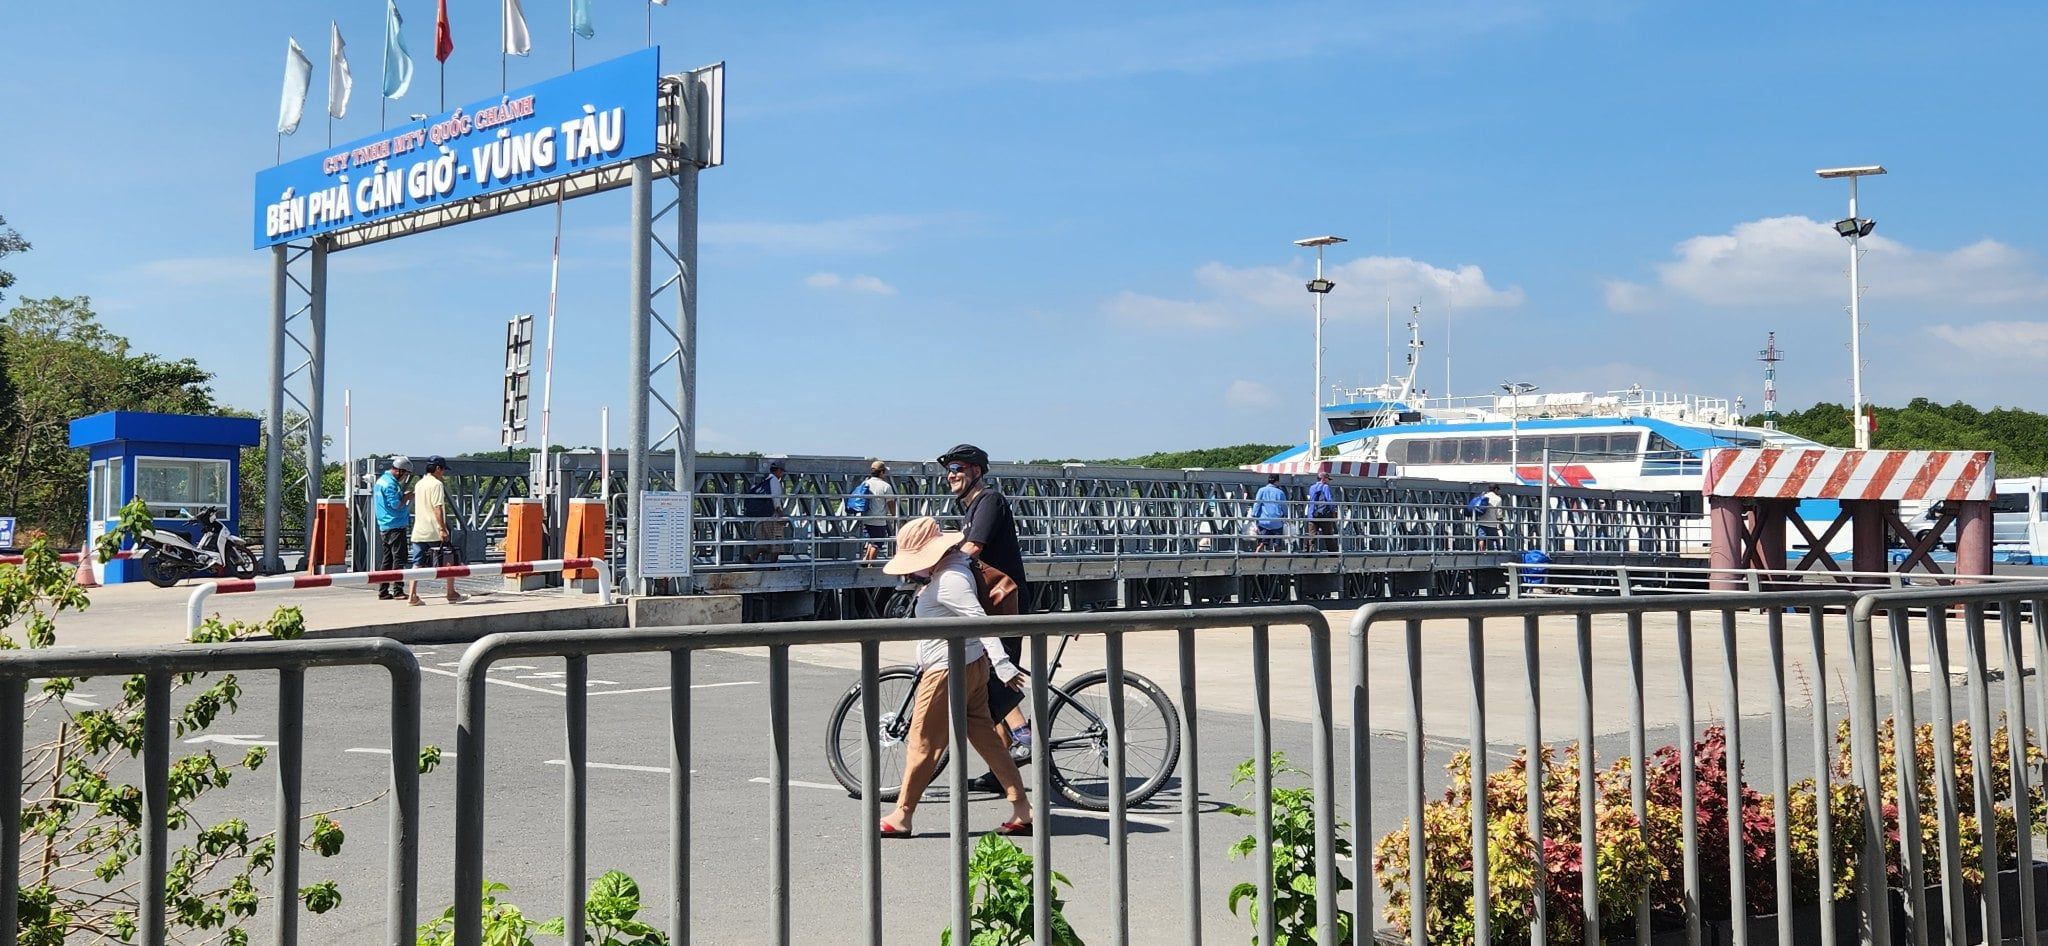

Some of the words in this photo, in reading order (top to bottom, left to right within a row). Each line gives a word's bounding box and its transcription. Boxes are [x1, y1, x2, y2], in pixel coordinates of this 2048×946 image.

[266, 186, 306, 237] BẾN
[308, 175, 352, 226] PHÀ
[355, 159, 405, 213] CẦN
[407, 145, 458, 199] GIỜ
[472, 127, 556, 184] VŨNG
[561, 104, 625, 162] TÀU
[323, 152, 350, 175] CTY
[351, 139, 392, 167] TNHH
[393, 128, 428, 154] MTV
[429, 107, 473, 145] QUỐC
[474, 95, 535, 130] CHÁNH
